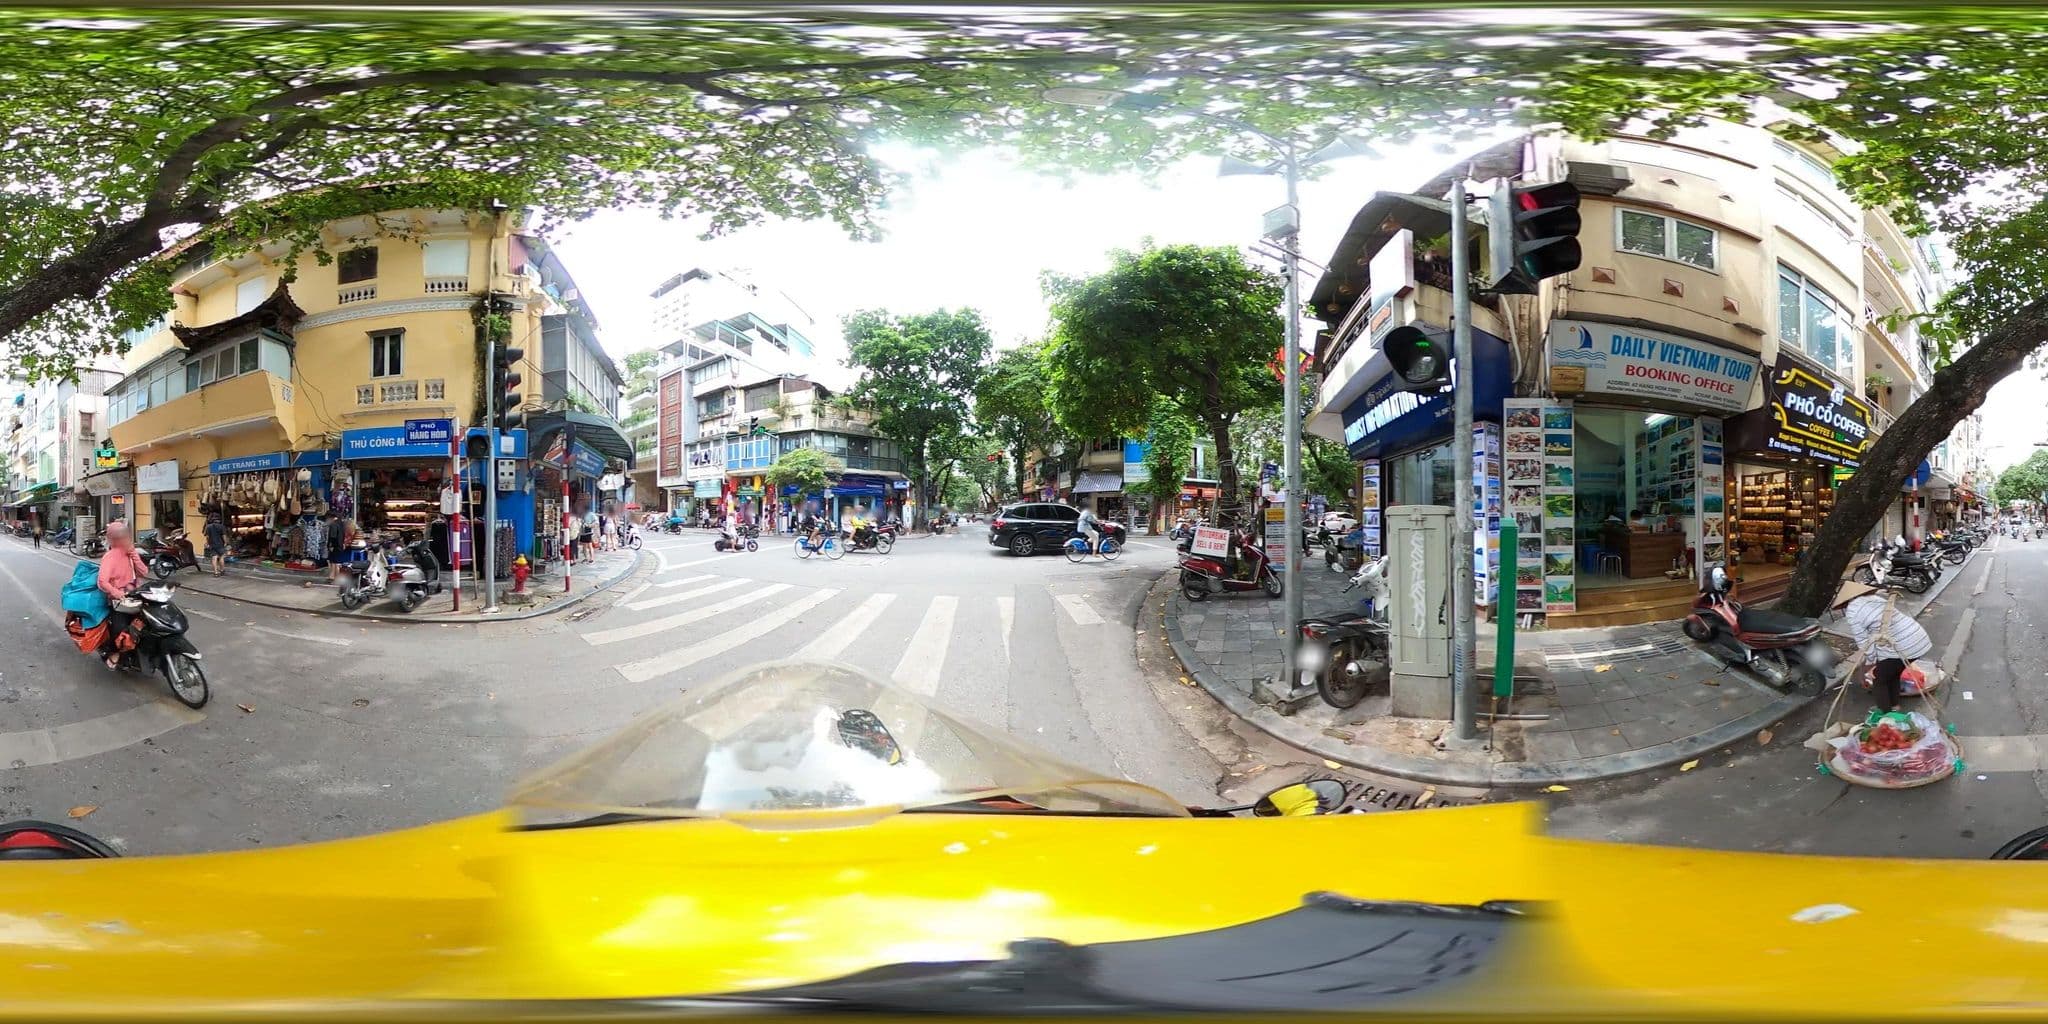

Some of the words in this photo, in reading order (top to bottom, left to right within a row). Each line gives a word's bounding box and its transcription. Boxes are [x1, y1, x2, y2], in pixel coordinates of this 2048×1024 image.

[1611, 334, 1658, 360] DAILY
[1659, 342, 1720, 374] VIETNAM
[1722, 358, 1753, 381] TOUR
[1625, 364, 1691, 385] BOOKING
[1694, 376, 1736, 394] OFFICE
[1784, 392, 1817, 416] PHỐ
[1816, 403, 1834, 423] CỔ
[1833, 413, 1866, 438] COFFEE
[1809, 423, 1832, 438] COFFEE
[350, 436, 367, 448] THỦ
[369, 436, 395, 448] CÔNG
[230, 461, 256, 470] TRANG
[1198, 529, 1227, 541] MOTORBIKE
